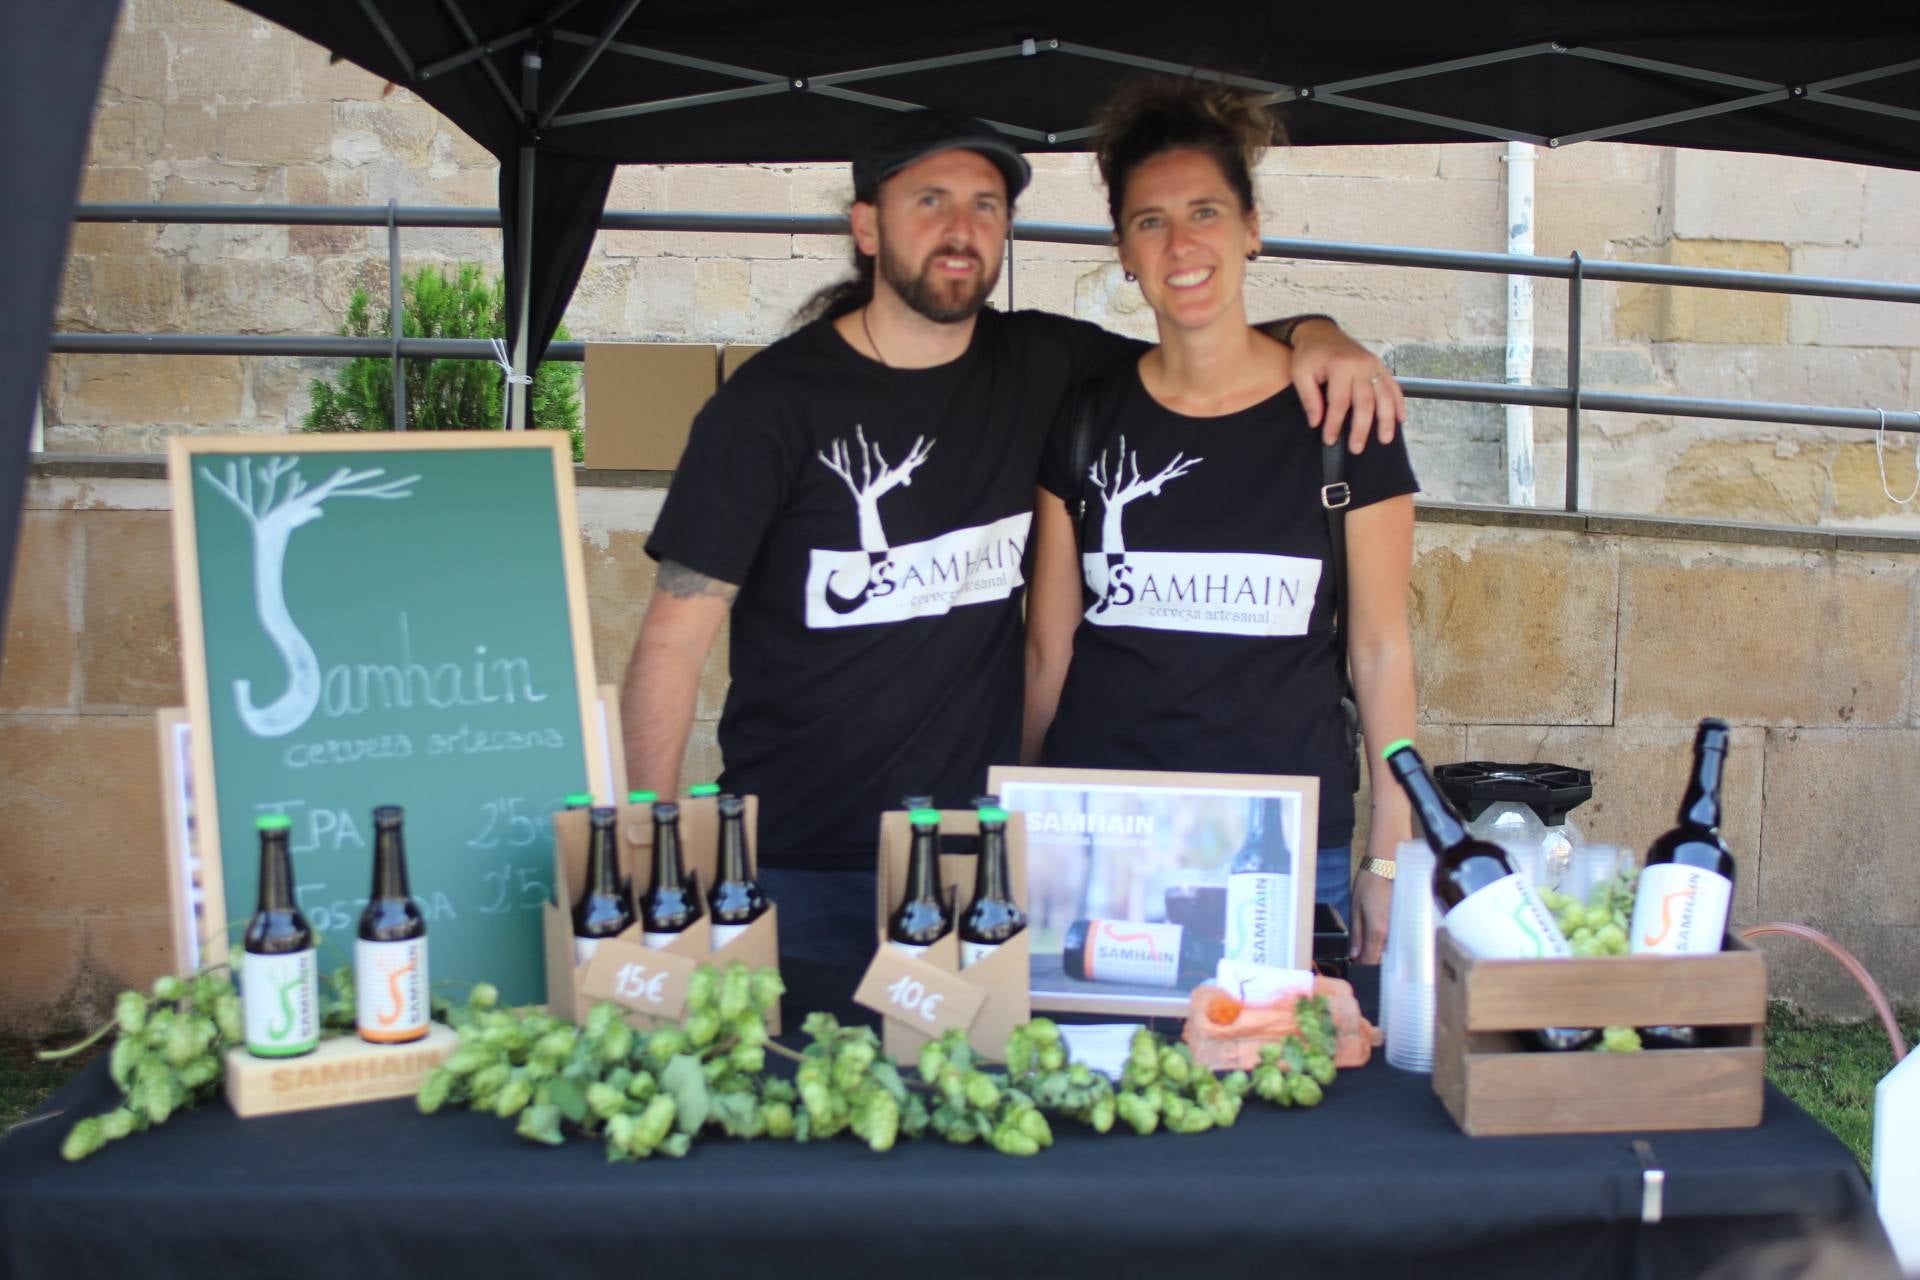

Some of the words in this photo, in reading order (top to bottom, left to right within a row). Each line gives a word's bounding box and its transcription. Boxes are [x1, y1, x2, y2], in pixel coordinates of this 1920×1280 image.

[870, 535, 1028, 598] SAMHAIN
[1109, 563, 1300, 607] SAMHAIN
[1205, 609, 1271, 624] artesanal
[1026, 811, 1155, 834] SAMHAIN
[1253, 877, 1269, 963] SAMHAIN
[1097, 944, 1175, 964] SAMHAIN
[615, 961, 669, 1004] 15€
[886, 975, 945, 1023] 10€
[271, 1049, 443, 1092] SAMHAIN
